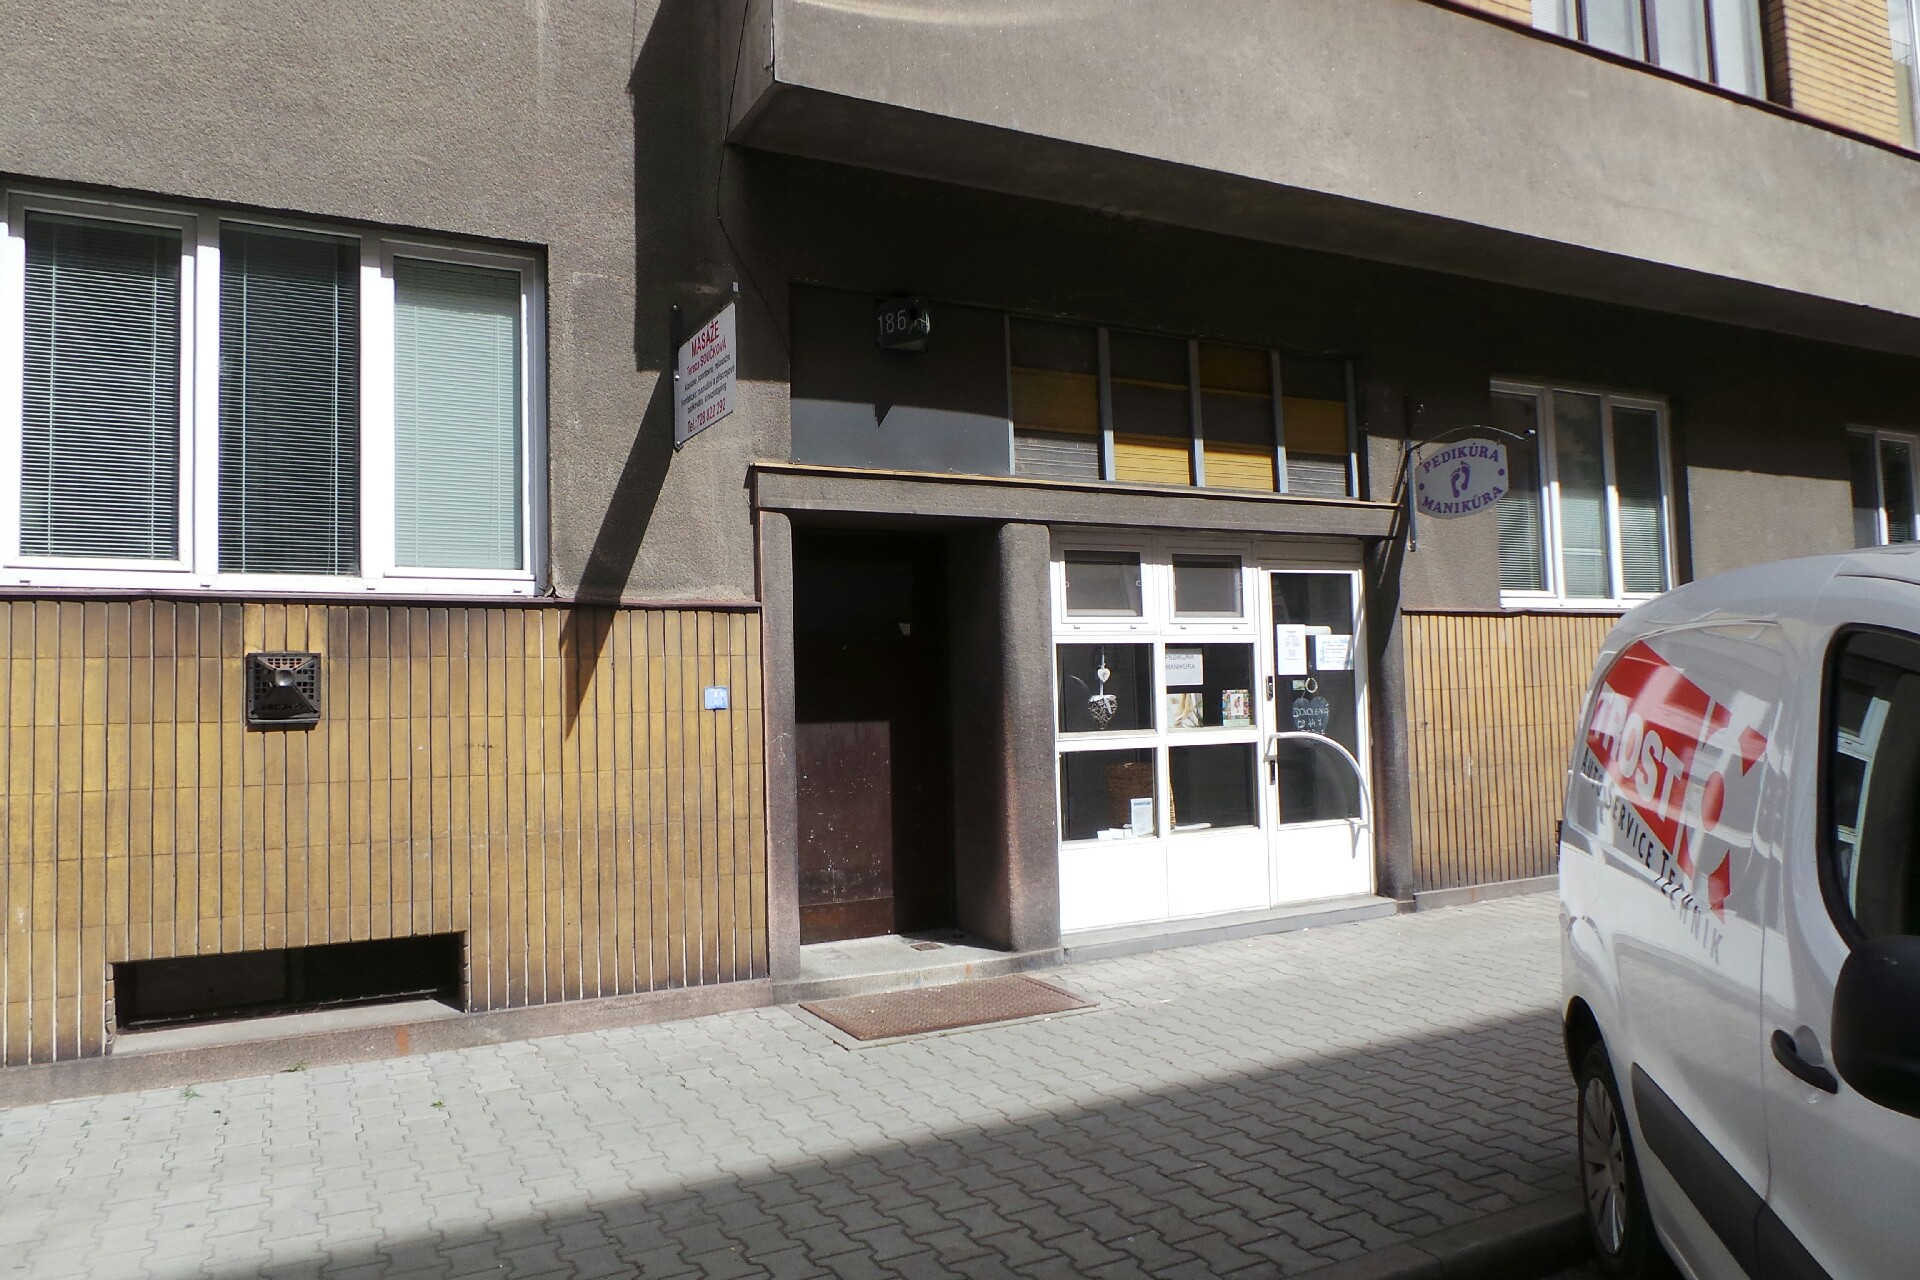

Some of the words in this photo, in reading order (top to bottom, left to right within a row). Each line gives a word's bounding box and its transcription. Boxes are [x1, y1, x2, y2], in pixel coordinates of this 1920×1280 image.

[691, 320, 719, 358] MASÁŽE
[1423, 443, 1498, 473] PEDIKÚRA
[1423, 486, 1503, 513] MANIKÚRA
[1591, 692, 1685, 822] TROST
